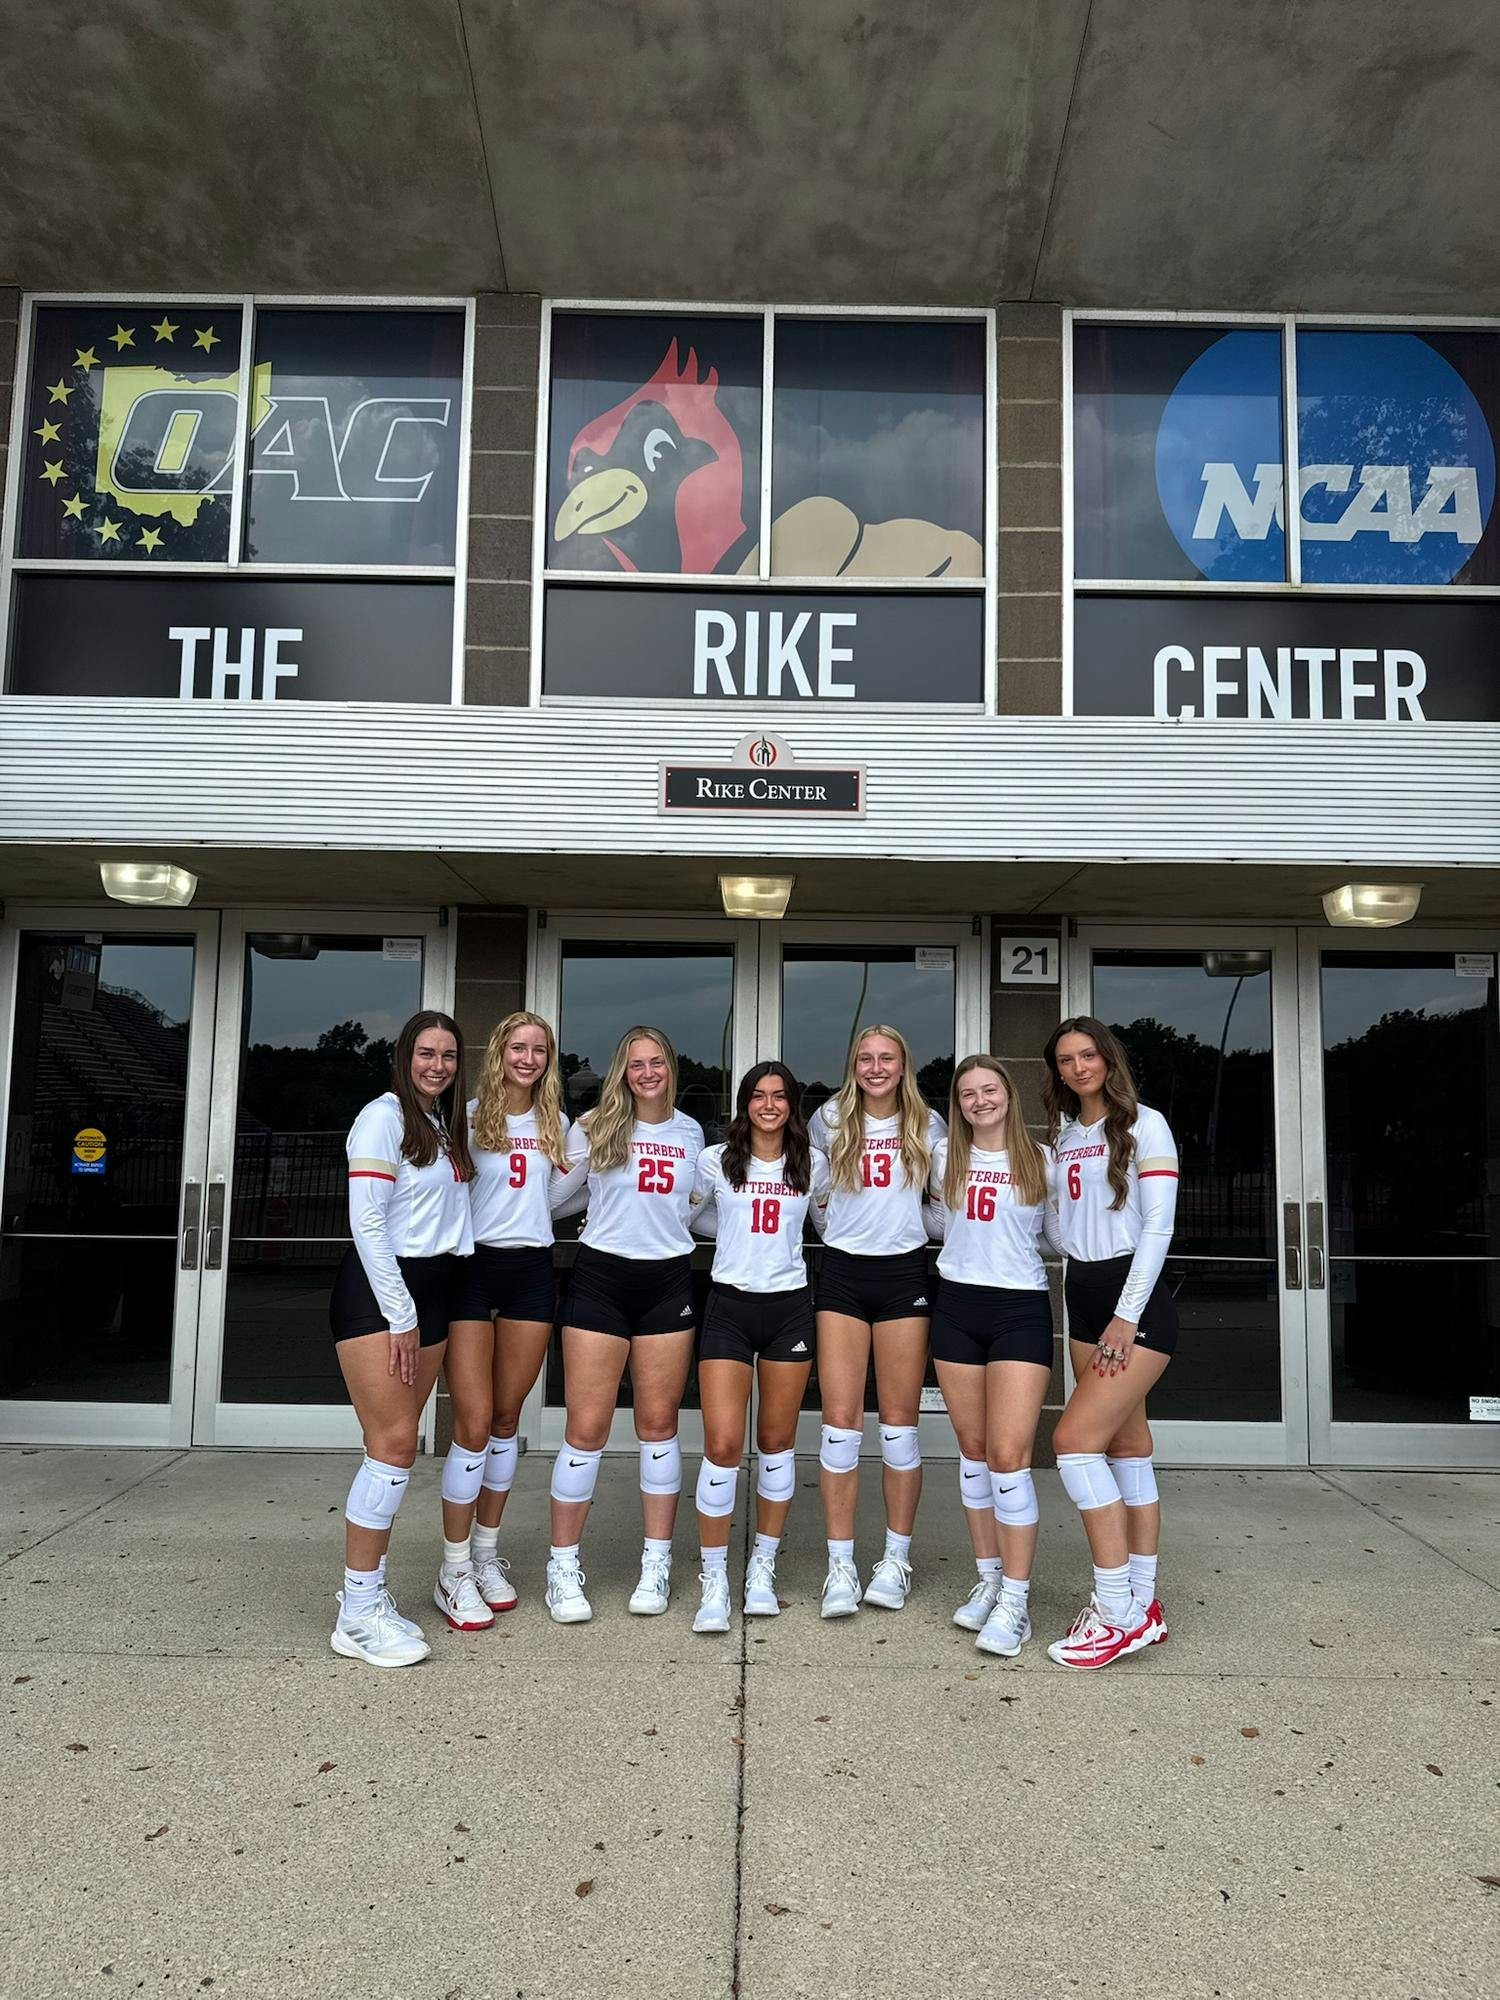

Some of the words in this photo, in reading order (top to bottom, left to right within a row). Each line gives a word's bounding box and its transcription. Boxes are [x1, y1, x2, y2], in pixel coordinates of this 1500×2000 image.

[110, 388, 451, 502] OAC
[1192, 463, 1483, 544] NCAA
[168, 626, 303, 700] THE
[693, 609, 857, 698] RIKE
[1153, 644, 1427, 722] CENTER
[696, 777, 745, 799] RIKE
[749, 778, 828, 801] CENTER
[1011, 946, 1048, 976] 21
[629, 1141, 686, 1160] TTERBEIN
[508, 1153, 527, 1189] 9
[638, 1157, 675, 1194] 25
[862, 1153, 891, 1188] 13
[1067, 1163, 1081, 1201] 6
[751, 1198, 781, 1234] 18
[966, 1185, 998, 1222] 16
